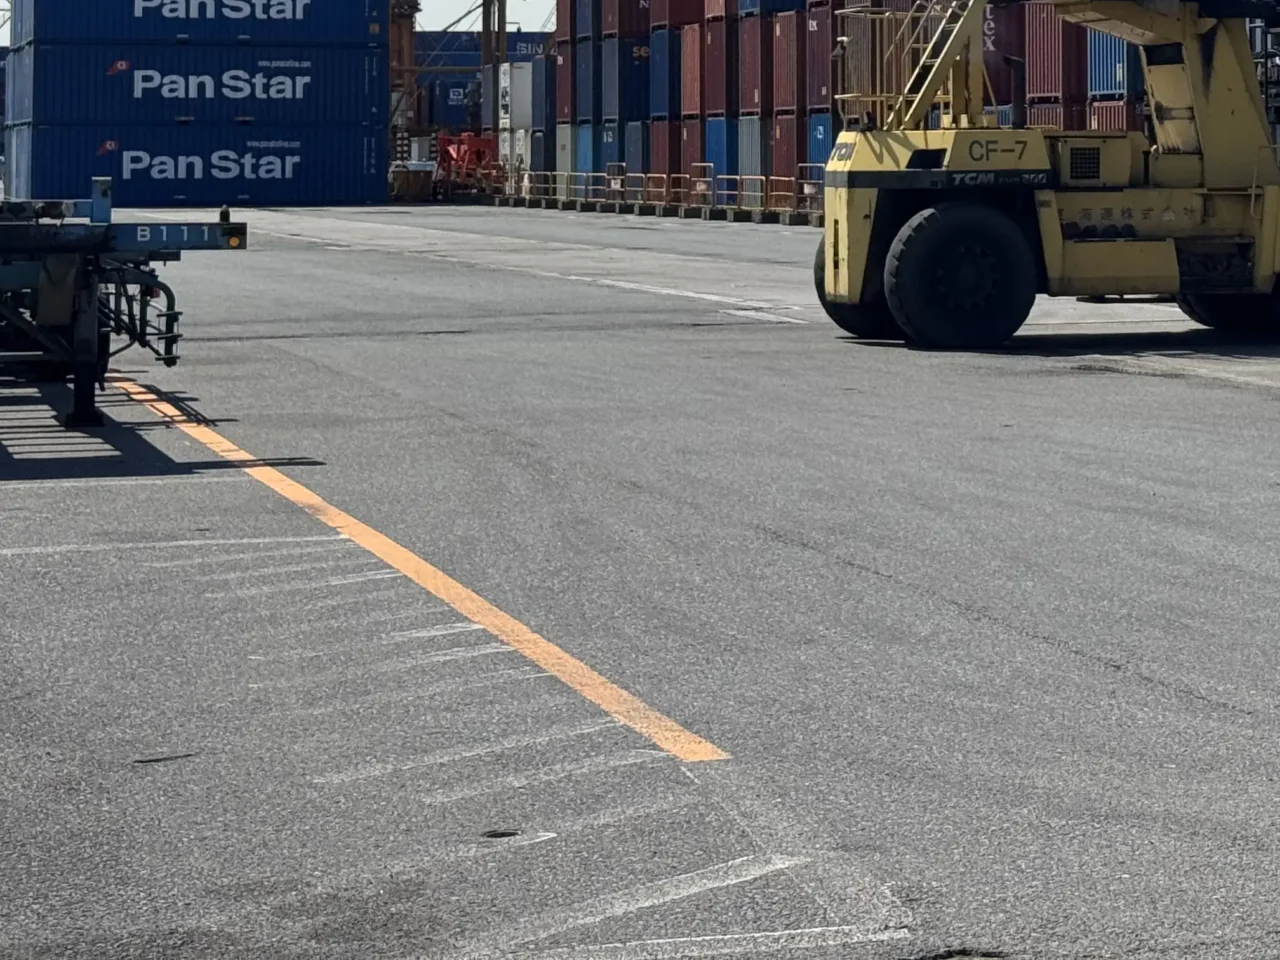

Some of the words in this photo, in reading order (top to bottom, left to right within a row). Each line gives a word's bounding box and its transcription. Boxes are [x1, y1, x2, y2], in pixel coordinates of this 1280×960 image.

[983, 3, 996, 51] tex
[969, 140, 1028, 161] CF-7
[952, 172, 995, 186] TCM
